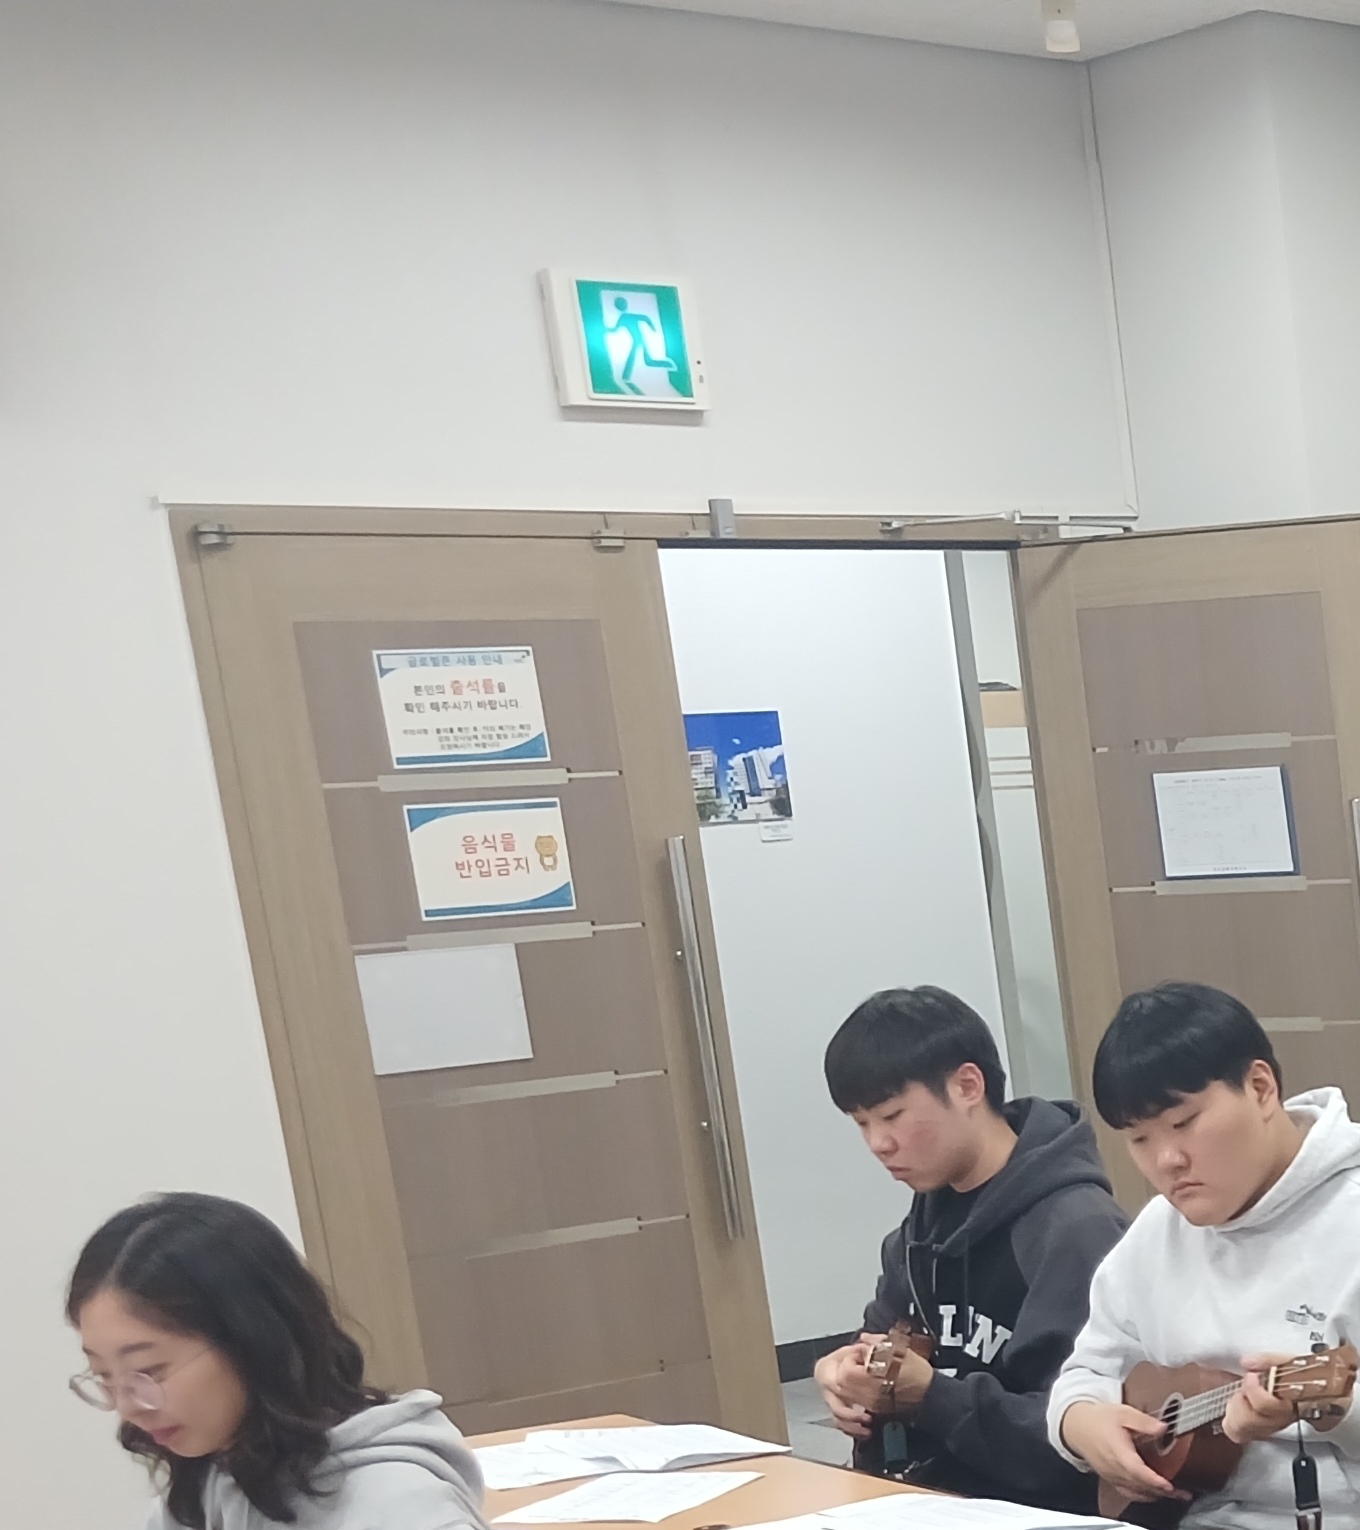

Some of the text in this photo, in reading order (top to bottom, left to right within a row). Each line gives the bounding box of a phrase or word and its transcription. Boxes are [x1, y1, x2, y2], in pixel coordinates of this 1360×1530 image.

[456, 654, 477, 667] 사용
[481, 653, 504, 666] 안내
[413, 683, 446, 697] 본인의
[404, 702, 426, 714] 확인
[460, 832, 517, 855] 음식물
[454, 857, 531, 879] 반입금지
